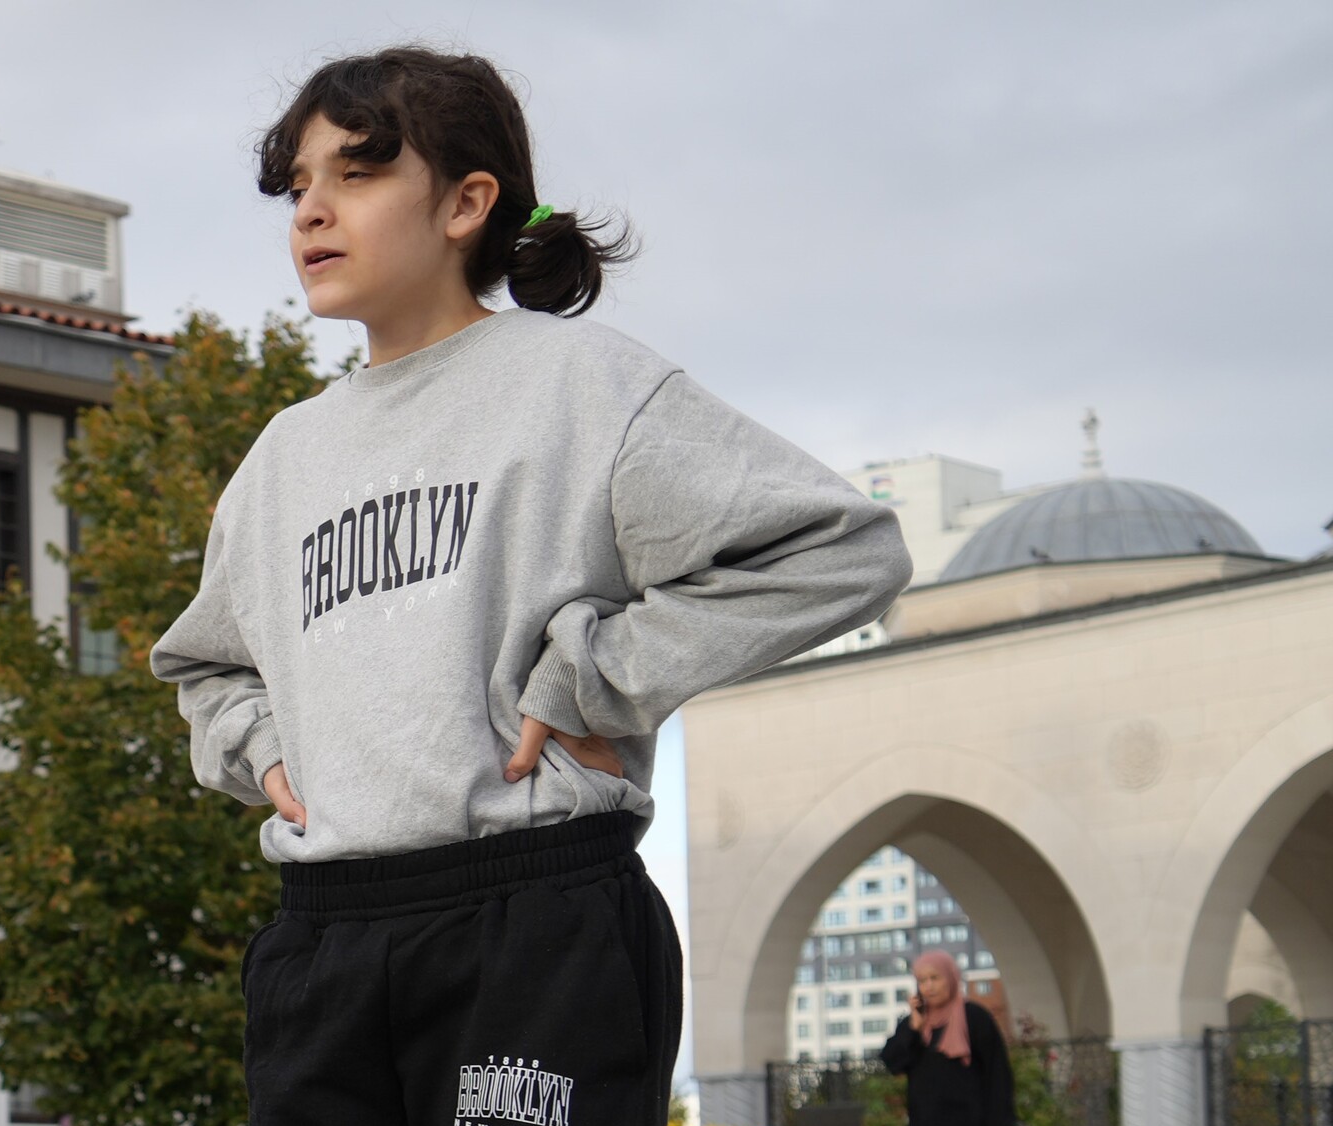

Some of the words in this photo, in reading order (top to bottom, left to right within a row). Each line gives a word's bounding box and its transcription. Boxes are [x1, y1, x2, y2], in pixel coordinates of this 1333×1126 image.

[343, 468, 426, 504] 1898
[301, 481, 479, 634] BROOKLYN
[383, 576, 458, 622] YORK
[487, 1054, 540, 1069] 1898
